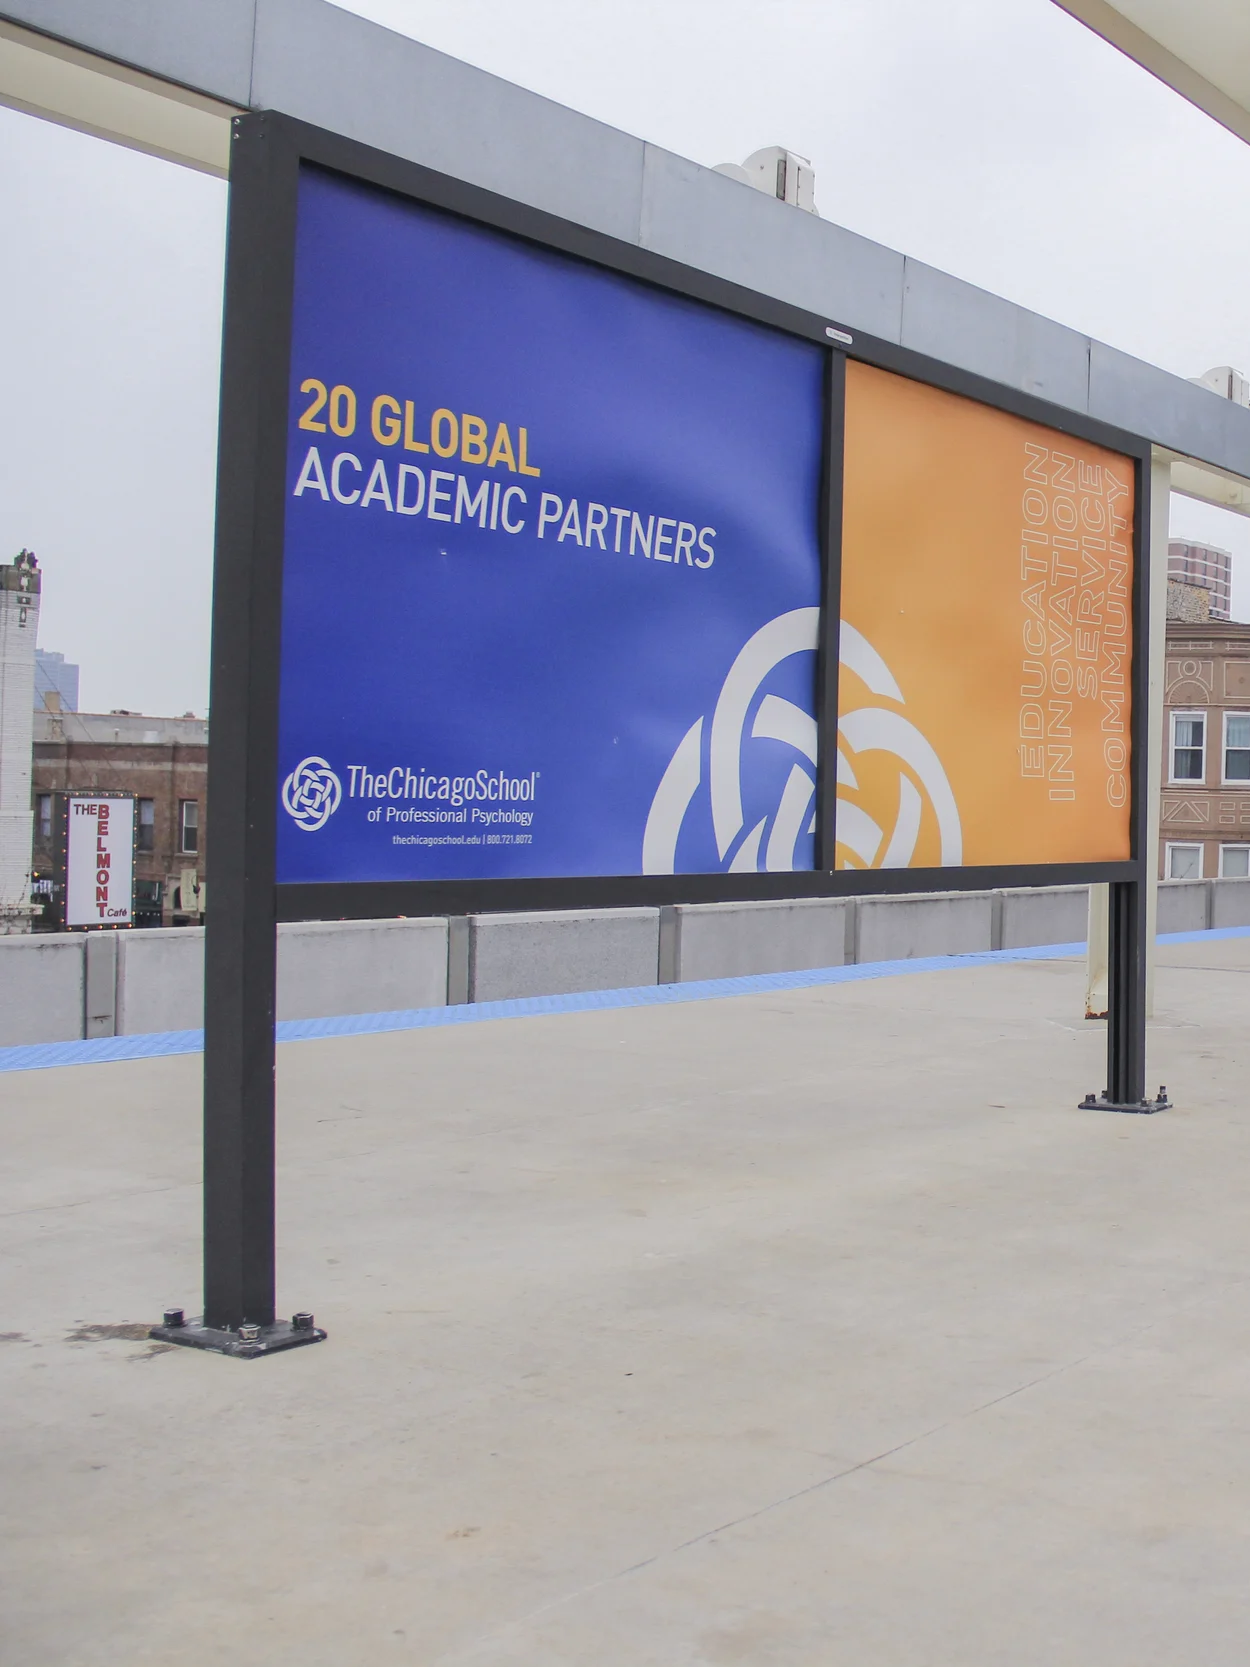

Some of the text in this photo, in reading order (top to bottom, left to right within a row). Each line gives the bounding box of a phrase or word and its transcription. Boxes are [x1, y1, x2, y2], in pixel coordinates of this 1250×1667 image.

[298, 378, 541, 477] 20 GLOBAL
[293, 446, 717, 569] ACADEMIC PARTNERS
[1019, 442, 1048, 777] EDUCATION
[1048, 451, 1078, 801] INNOVATION
[1076, 460, 1106, 699] SERVICE
[1101, 468, 1129, 808] COMMUNITY
[74, 803, 97, 816] THE
[96, 804, 111, 918] BELMONT
[367, 807, 534, 826] of Professional Psychology
[392, 834, 481, 847] thechicagoschool.edu
[107, 908, 127, 918] Café
